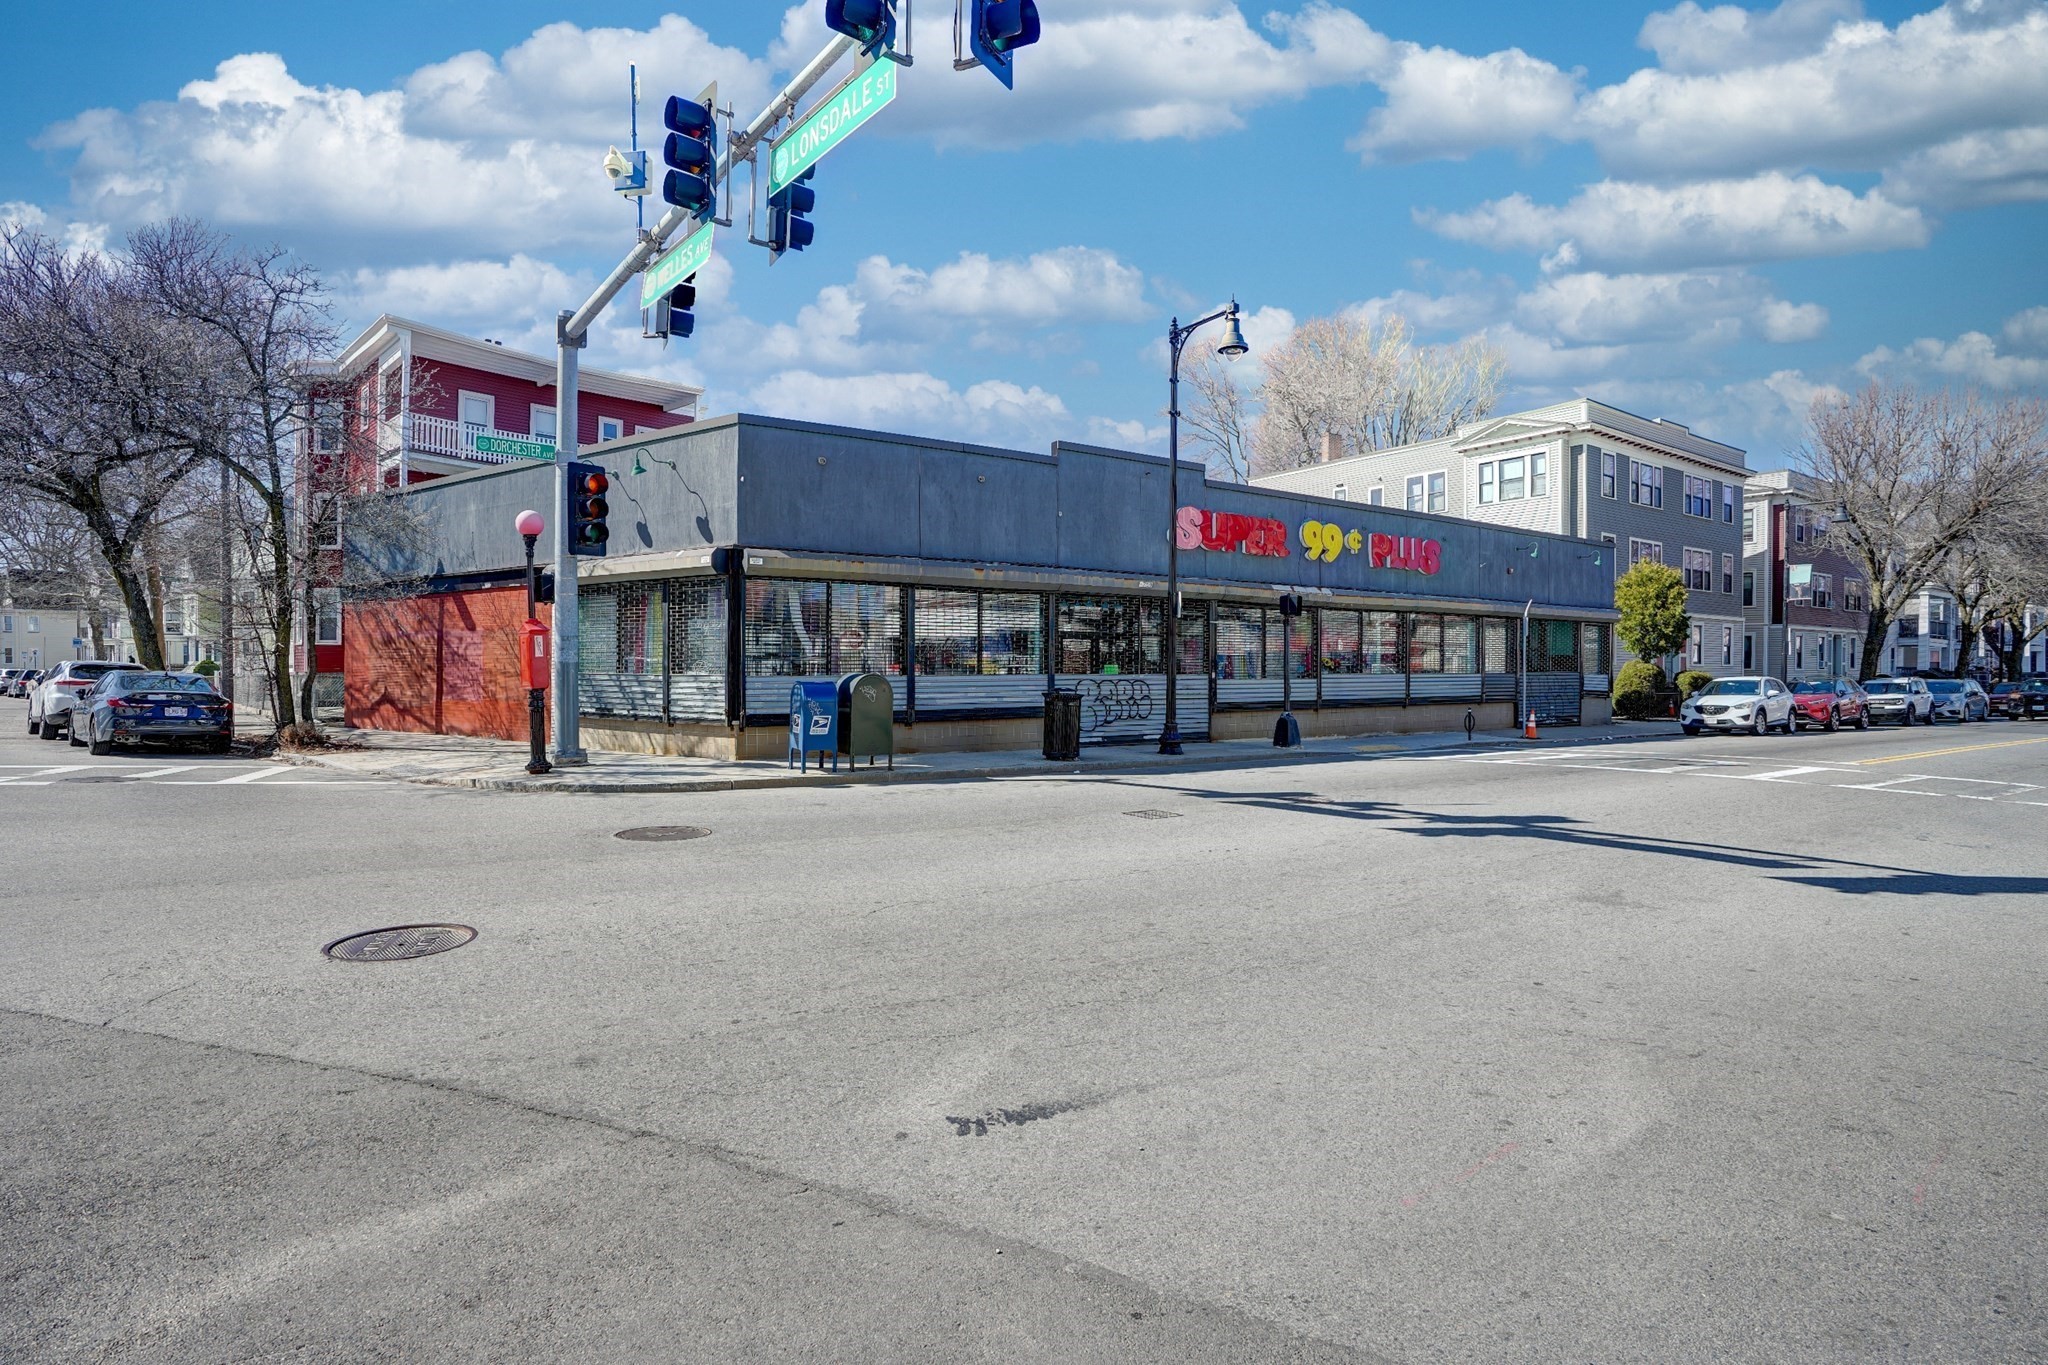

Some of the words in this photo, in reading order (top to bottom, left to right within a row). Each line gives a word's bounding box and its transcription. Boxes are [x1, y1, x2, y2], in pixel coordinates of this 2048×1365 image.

[791, 76, 873, 167] LONSDALE
[876, 70, 891, 96] ST
[695, 236, 709, 259] AVE
[490, 439, 541, 457] DORCHESTER
[1168, 505, 1290, 558] SUPER
[1368, 532, 1442, 576] PLUS
